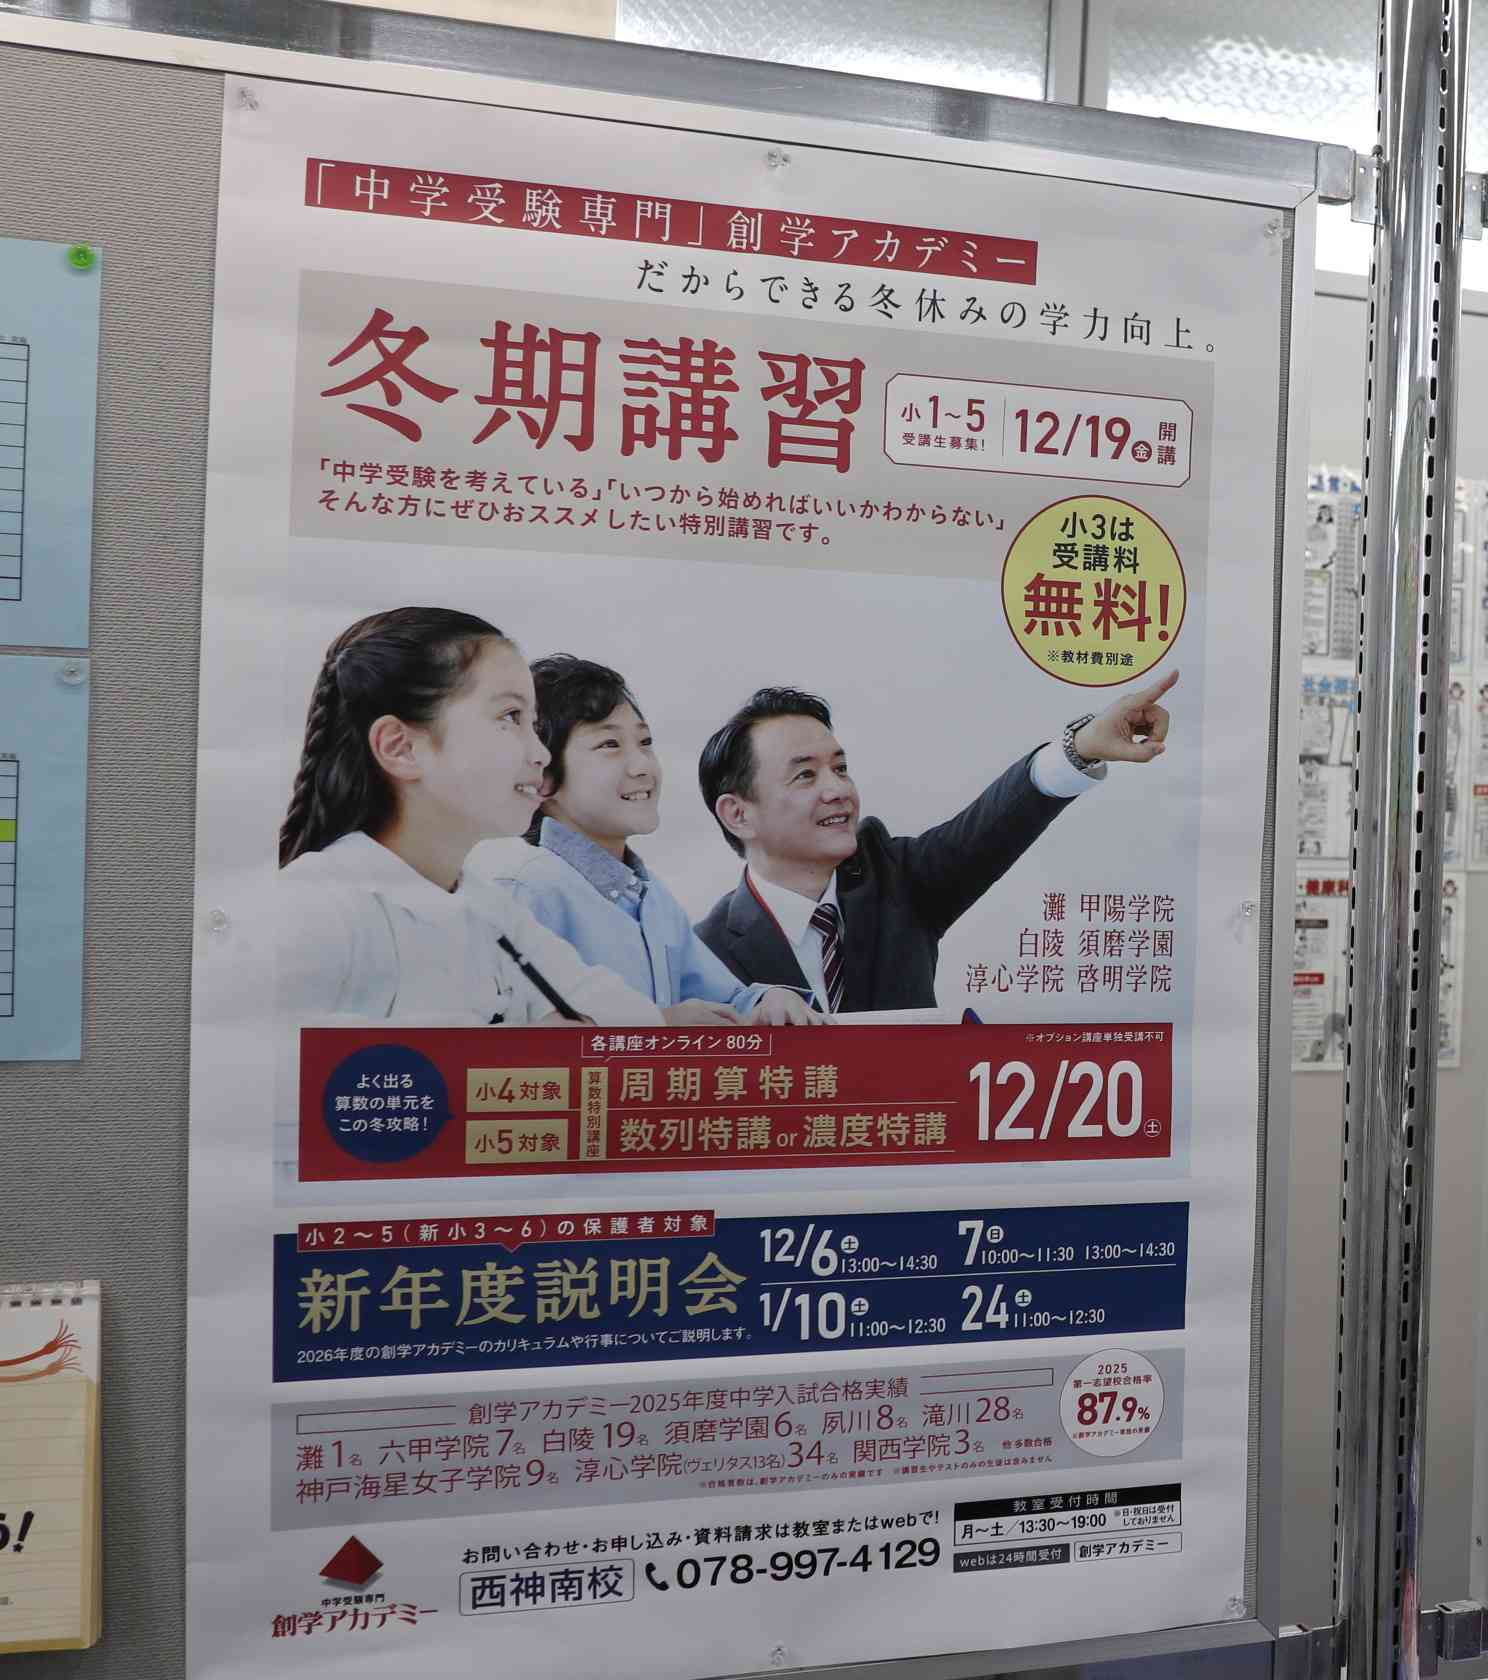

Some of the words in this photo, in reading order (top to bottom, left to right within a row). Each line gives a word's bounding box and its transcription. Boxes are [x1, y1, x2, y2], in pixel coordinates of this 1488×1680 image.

[638, 259, 1217, 352] だからできる冬休みの学力向上。
[319, 308, 866, 475] 冬期講習
[1014, 407, 1132, 460] 12/19
[1060, 511, 1135, 542] 小3は
[1052, 542, 1140, 575] 受講料
[1023, 572, 1170, 643] 無料!
[1042, 891, 1066, 923] 灘
[1079, 892, 1175, 923] 甲陽学院
[1018, 927, 1065, 958] 白陵
[1078, 928, 1174, 959] 須磨学園
[965, 962, 1065, 994] 淳心学院
[1077, 963, 1173, 994] 啓明学院
[355, 1073, 414, 1089] よく出る
[474, 1076, 563, 1102] 小4対象
[619, 1064, 839, 1104] 周期算特講
[334, 1094, 435, 1112] 算数の単元を
[968, 1058, 1145, 1142] 12/20
[338, 1116, 429, 1133] この冬攻略!
[474, 1129, 562, 1155] 小5対象
[759, 1223, 839, 1277] 12/6
[958, 1219, 985, 1266] 7
[296, 1250, 748, 1336] 新年度説明会
[960, 1284, 1010, 1332] 24
[759, 1287, 846, 1341] 1/10
[1097, 1362, 1129, 1375] 2025
[1076, 1390, 1151, 1426] 87.9%
[1012, 1491, 1119, 1513] 教室受付時間
[676, 1537, 941, 1590] 078-997-4129
[959, 1548, 1063, 1569] webは24時間受付
[1078, 1540, 1170, 1559] 創学アカデミー
[470, 1565, 624, 1610] 西神南校
[271, 1603, 439, 1638] 創学アカデミー
